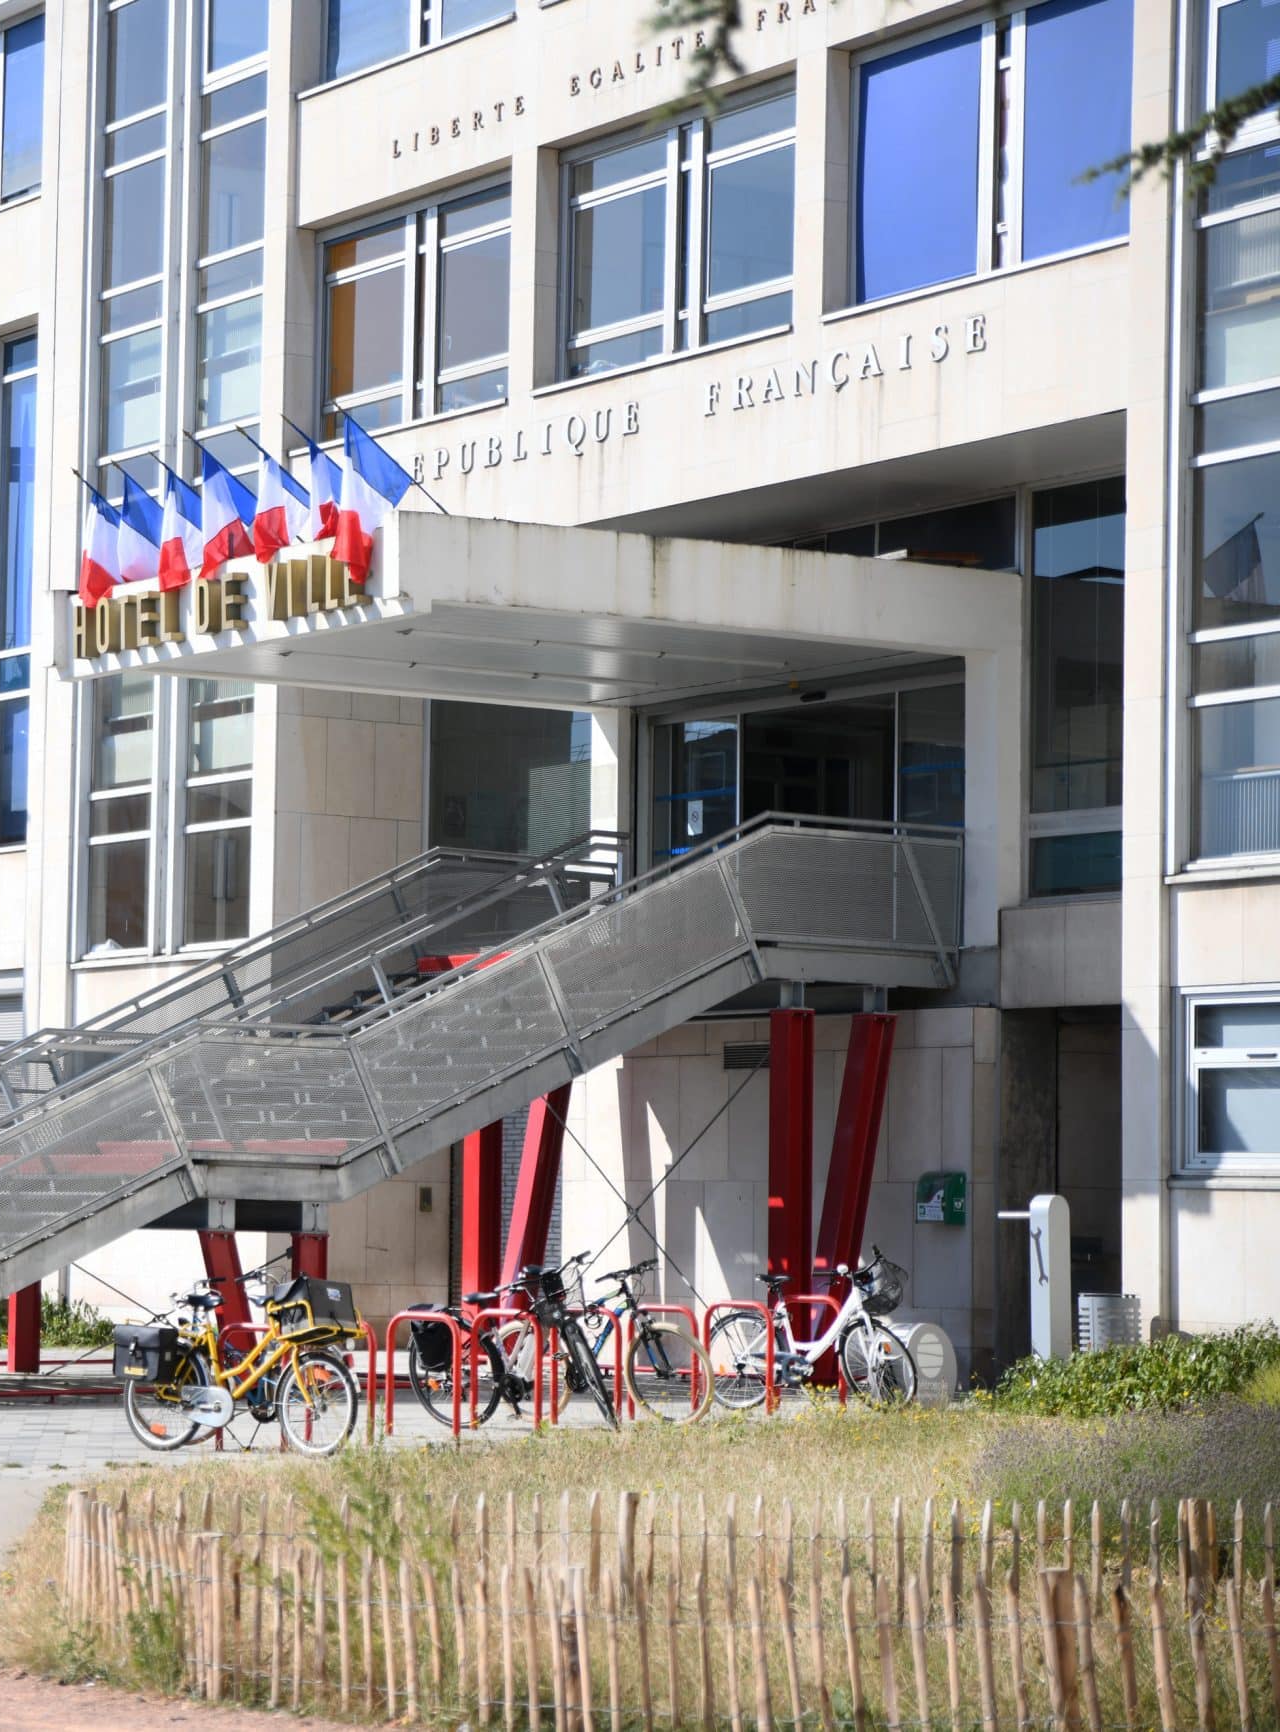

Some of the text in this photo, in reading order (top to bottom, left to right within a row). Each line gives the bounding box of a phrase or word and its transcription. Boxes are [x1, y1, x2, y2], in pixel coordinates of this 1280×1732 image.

[392, 95, 526, 159] LIBERTE
[569, 30, 707, 97] EGALITE
[409, 313, 988, 486] EPUBLIQUE FRANÇAISE
[73, 590, 186, 660] HOTEL
[195, 571, 249, 635] DE
